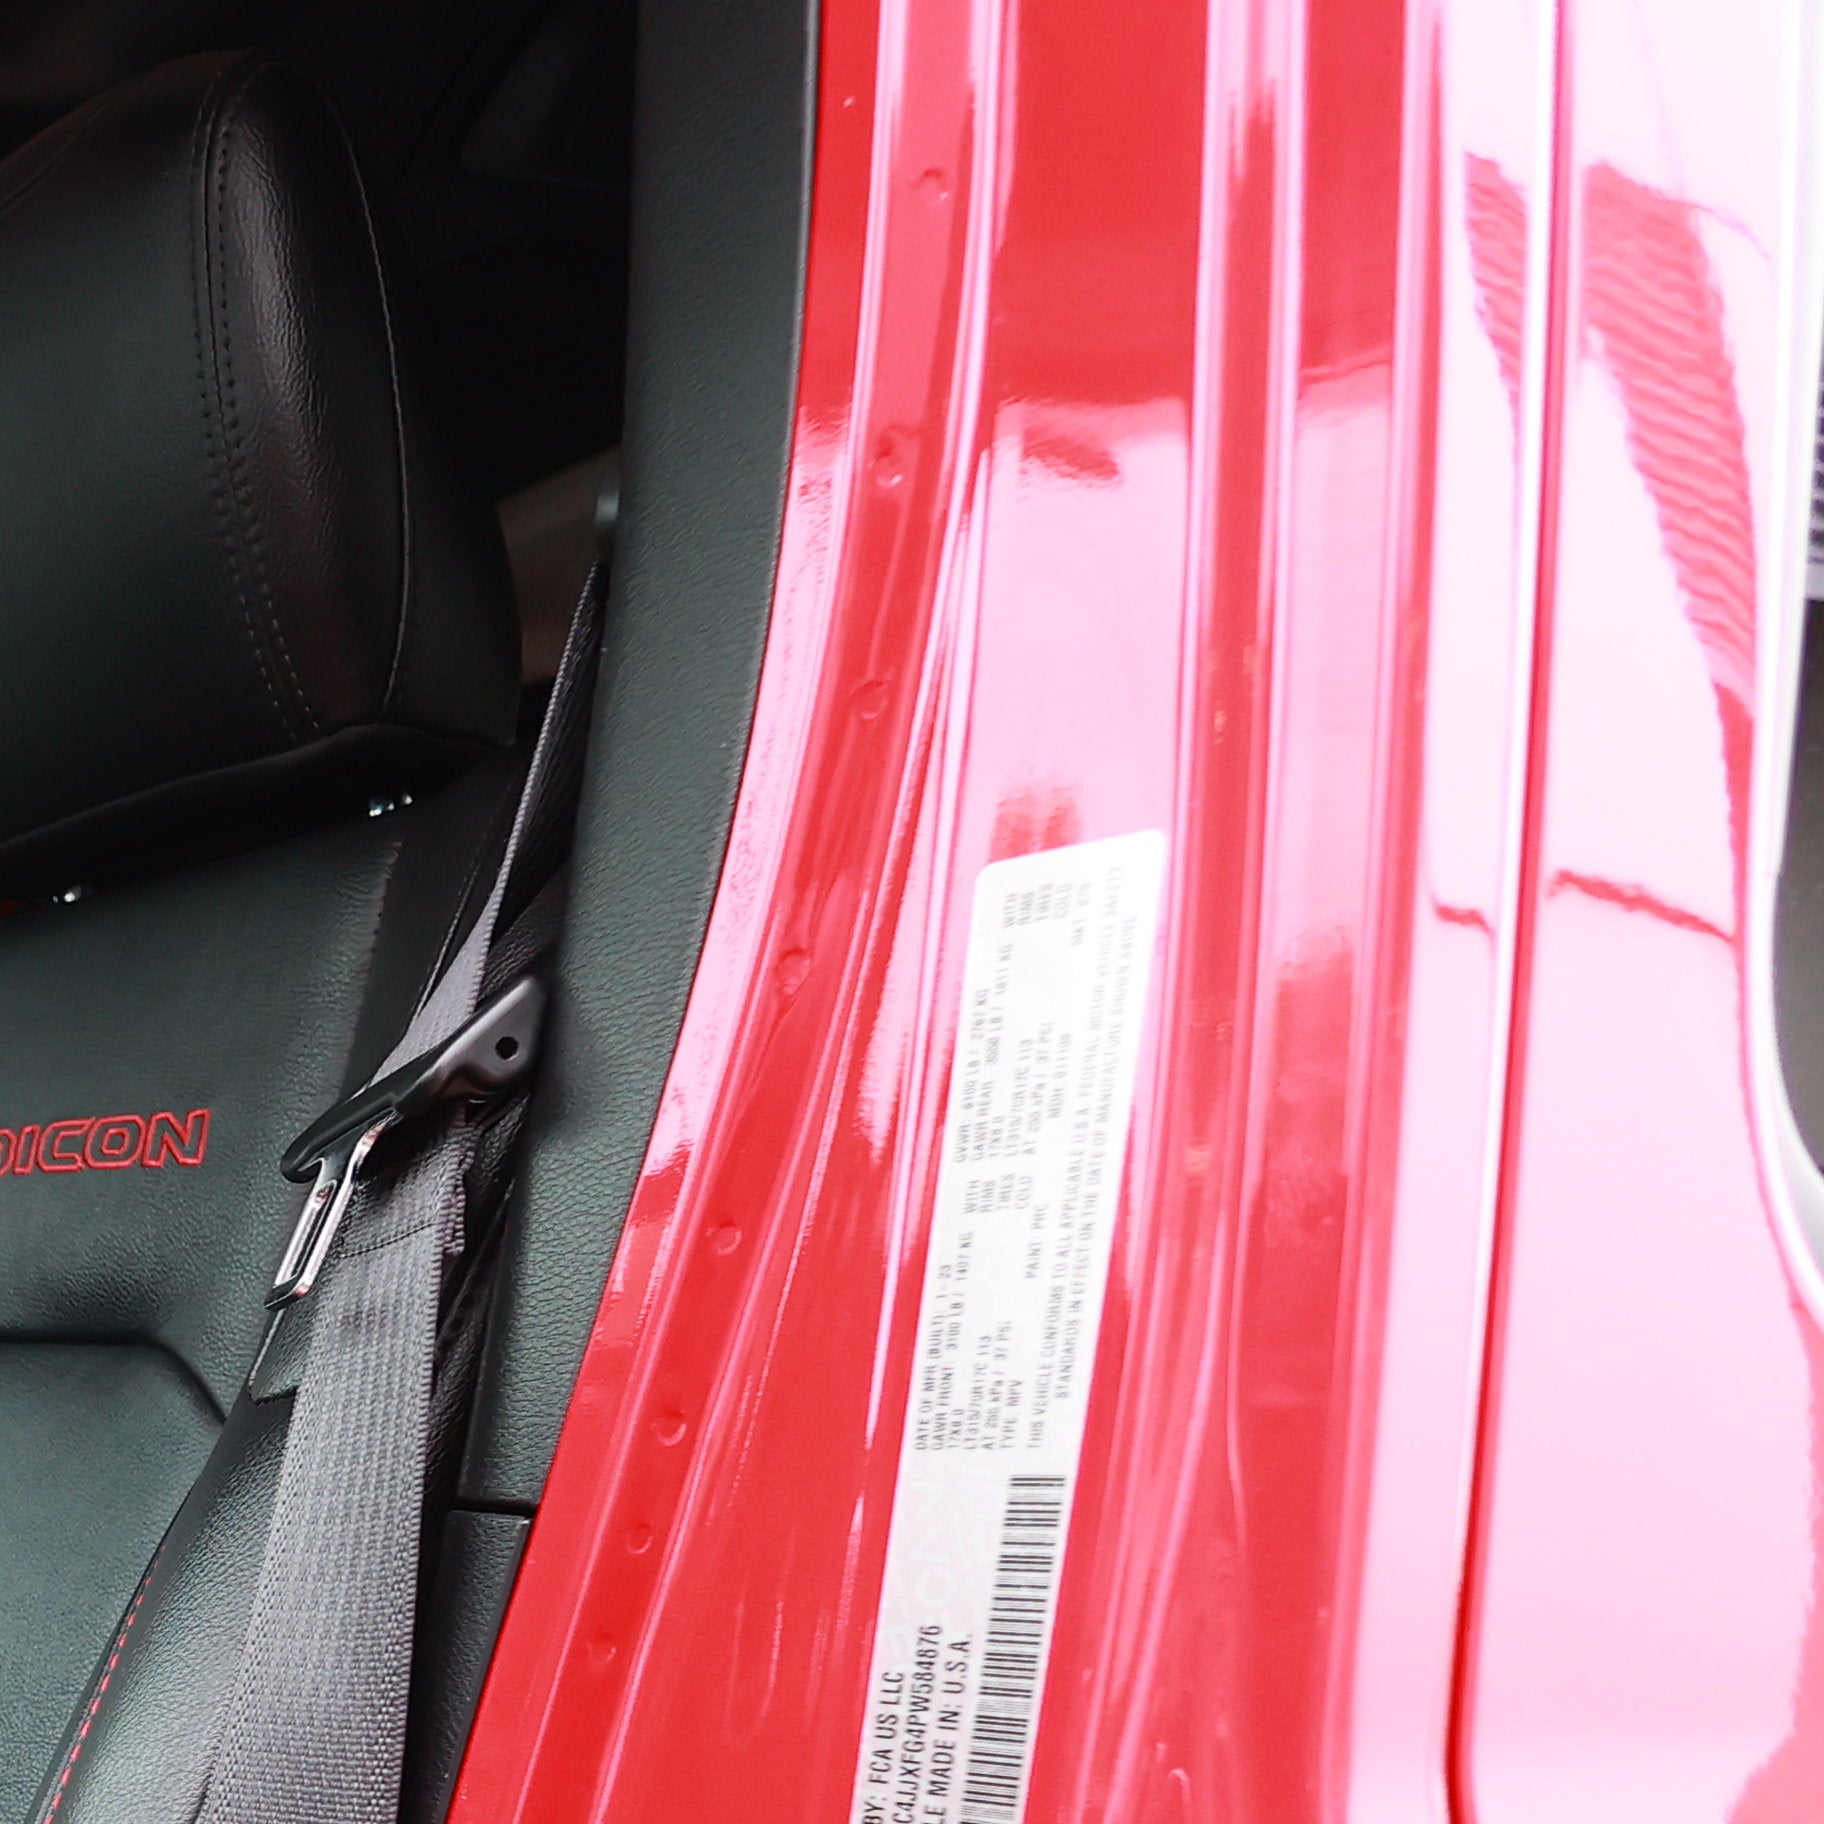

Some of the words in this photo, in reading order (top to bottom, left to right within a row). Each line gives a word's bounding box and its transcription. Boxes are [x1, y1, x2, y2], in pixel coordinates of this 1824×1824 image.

[964, 1179, 980, 1213] WITH
[923, 1364, 939, 1391] MFR
[920, 1397, 934, 1412] OF
[915, 1419, 931, 1449] DATE
[942, 1631, 972, 1695] U.S.A.
[879, 1670, 905, 1706] LLC
[874, 1712, 899, 1740] US
[936, 1702, 962, 1731] IN:
[868, 1746, 894, 1784] FCA
[927, 1738, 957, 1797] MADE
